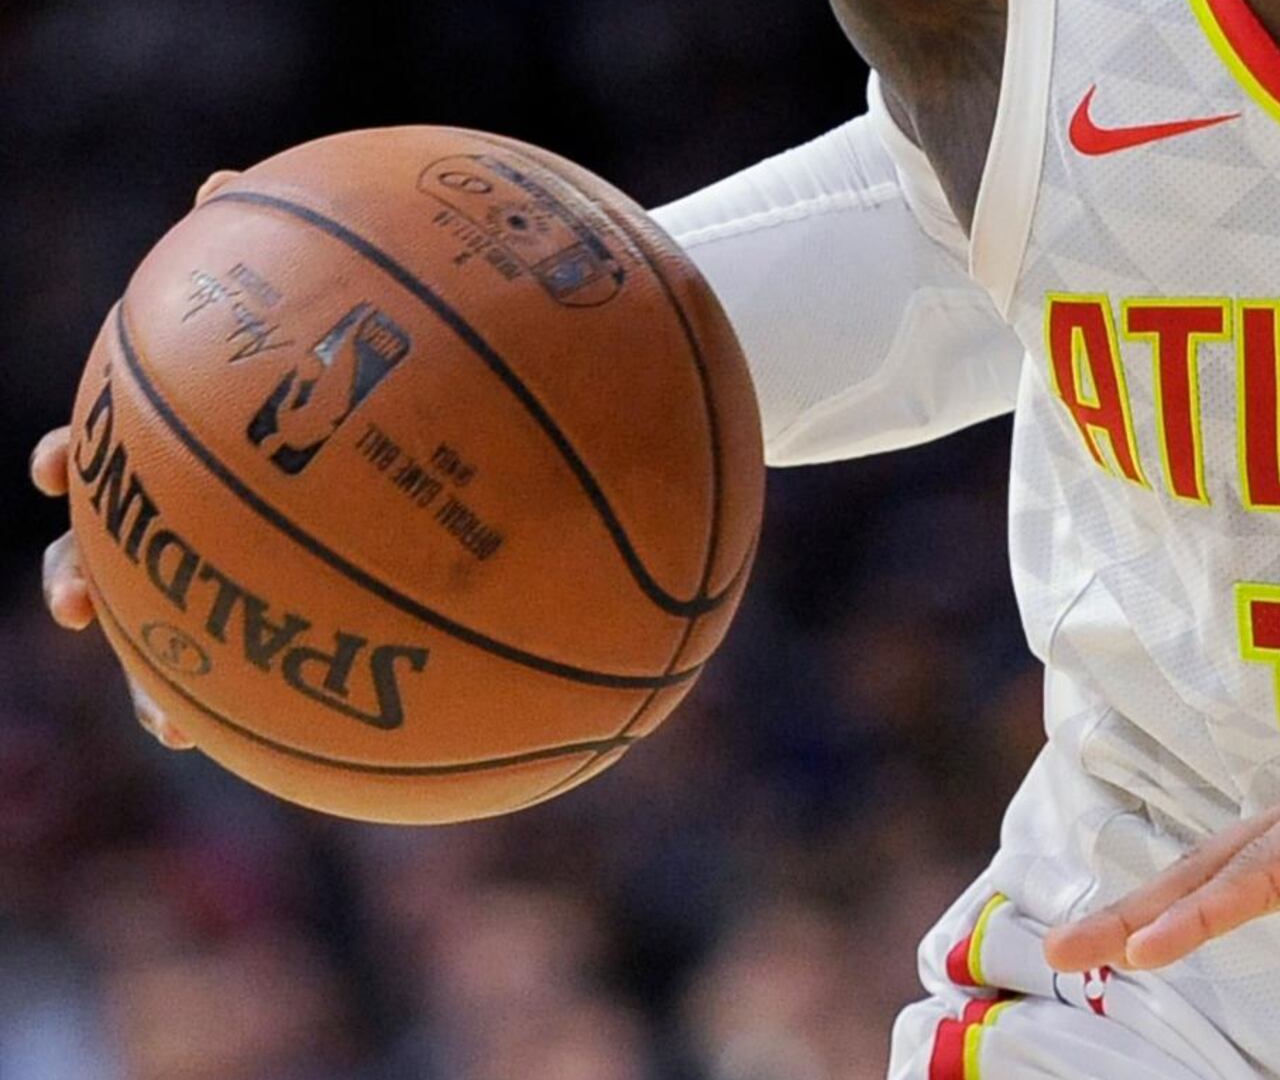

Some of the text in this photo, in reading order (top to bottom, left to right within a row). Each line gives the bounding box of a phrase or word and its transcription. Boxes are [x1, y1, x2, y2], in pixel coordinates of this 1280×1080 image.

[355, 422, 401, 471] BALL
[391, 457, 442, 508] GAME
[74, 380, 430, 731] SPALDING
